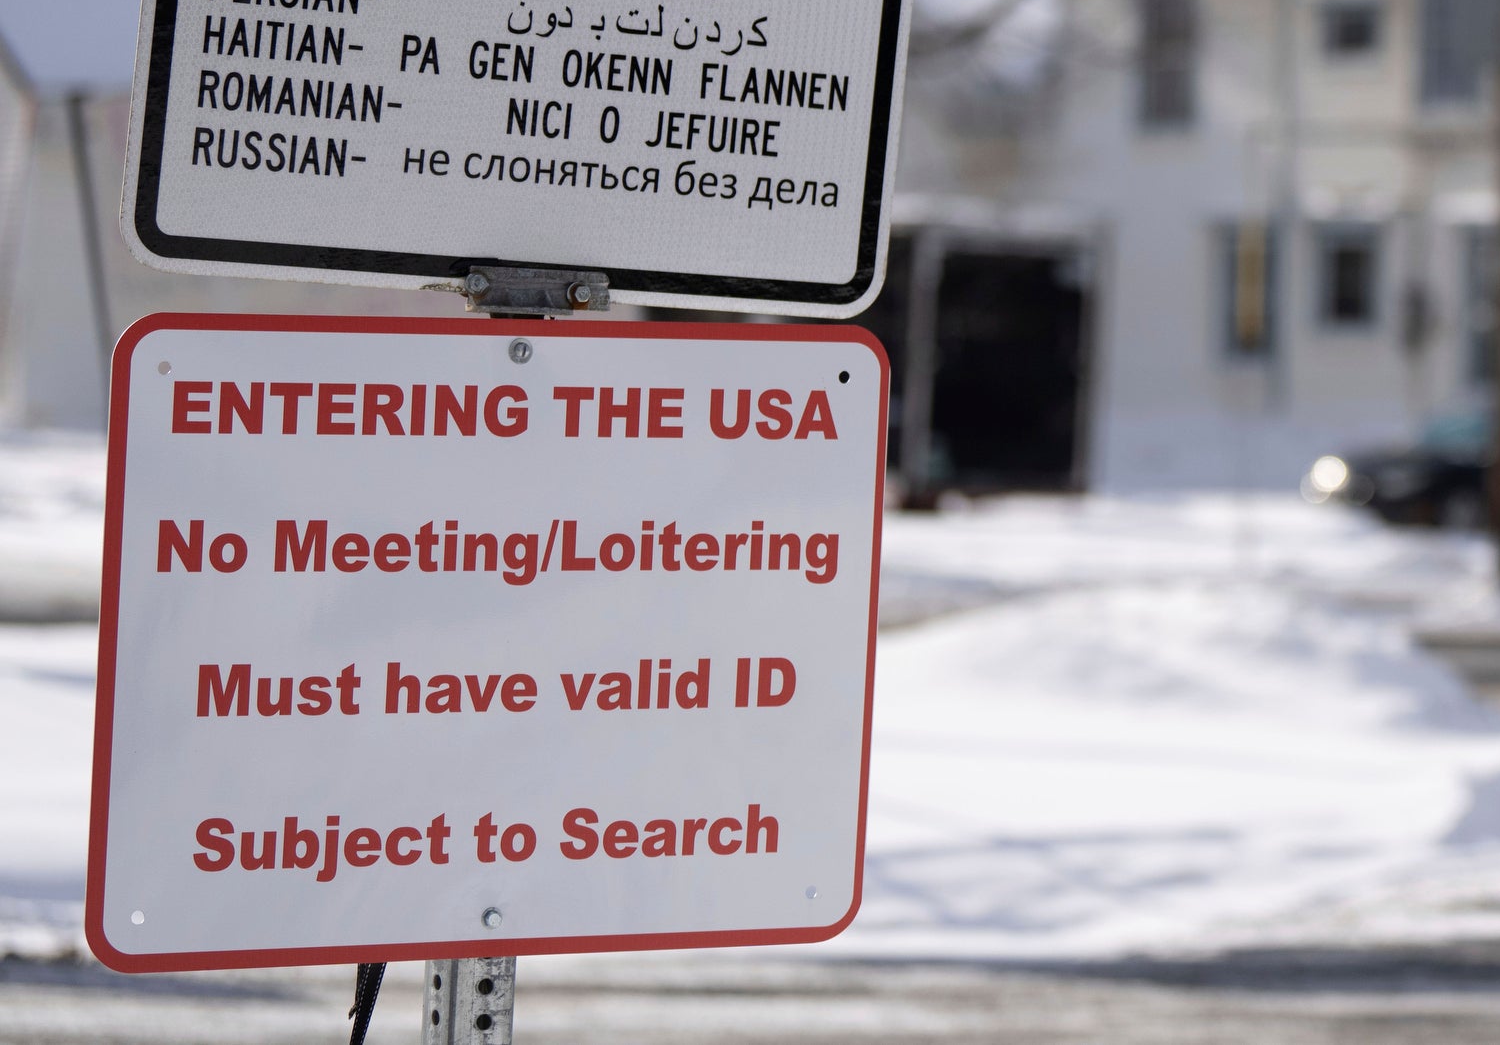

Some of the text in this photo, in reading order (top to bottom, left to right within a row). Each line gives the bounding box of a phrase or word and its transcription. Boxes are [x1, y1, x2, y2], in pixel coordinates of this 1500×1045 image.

[202, 14, 850, 112] HAITIAN- PA GEN OKENN FLANNEN
[197, 69, 781, 158] ROMANIAN- NICI O JEFUIRE
[191, 126, 367, 178] RUSSIAN-
[403, 147, 839, 211] не слоняться без дела
[171, 380, 838, 440] ENTERING THE USA
[157, 519, 839, 586] No Meeting/Loitering
[196, 657, 797, 717] Must have valid ID
[193, 804, 779, 882] Subject to Search
